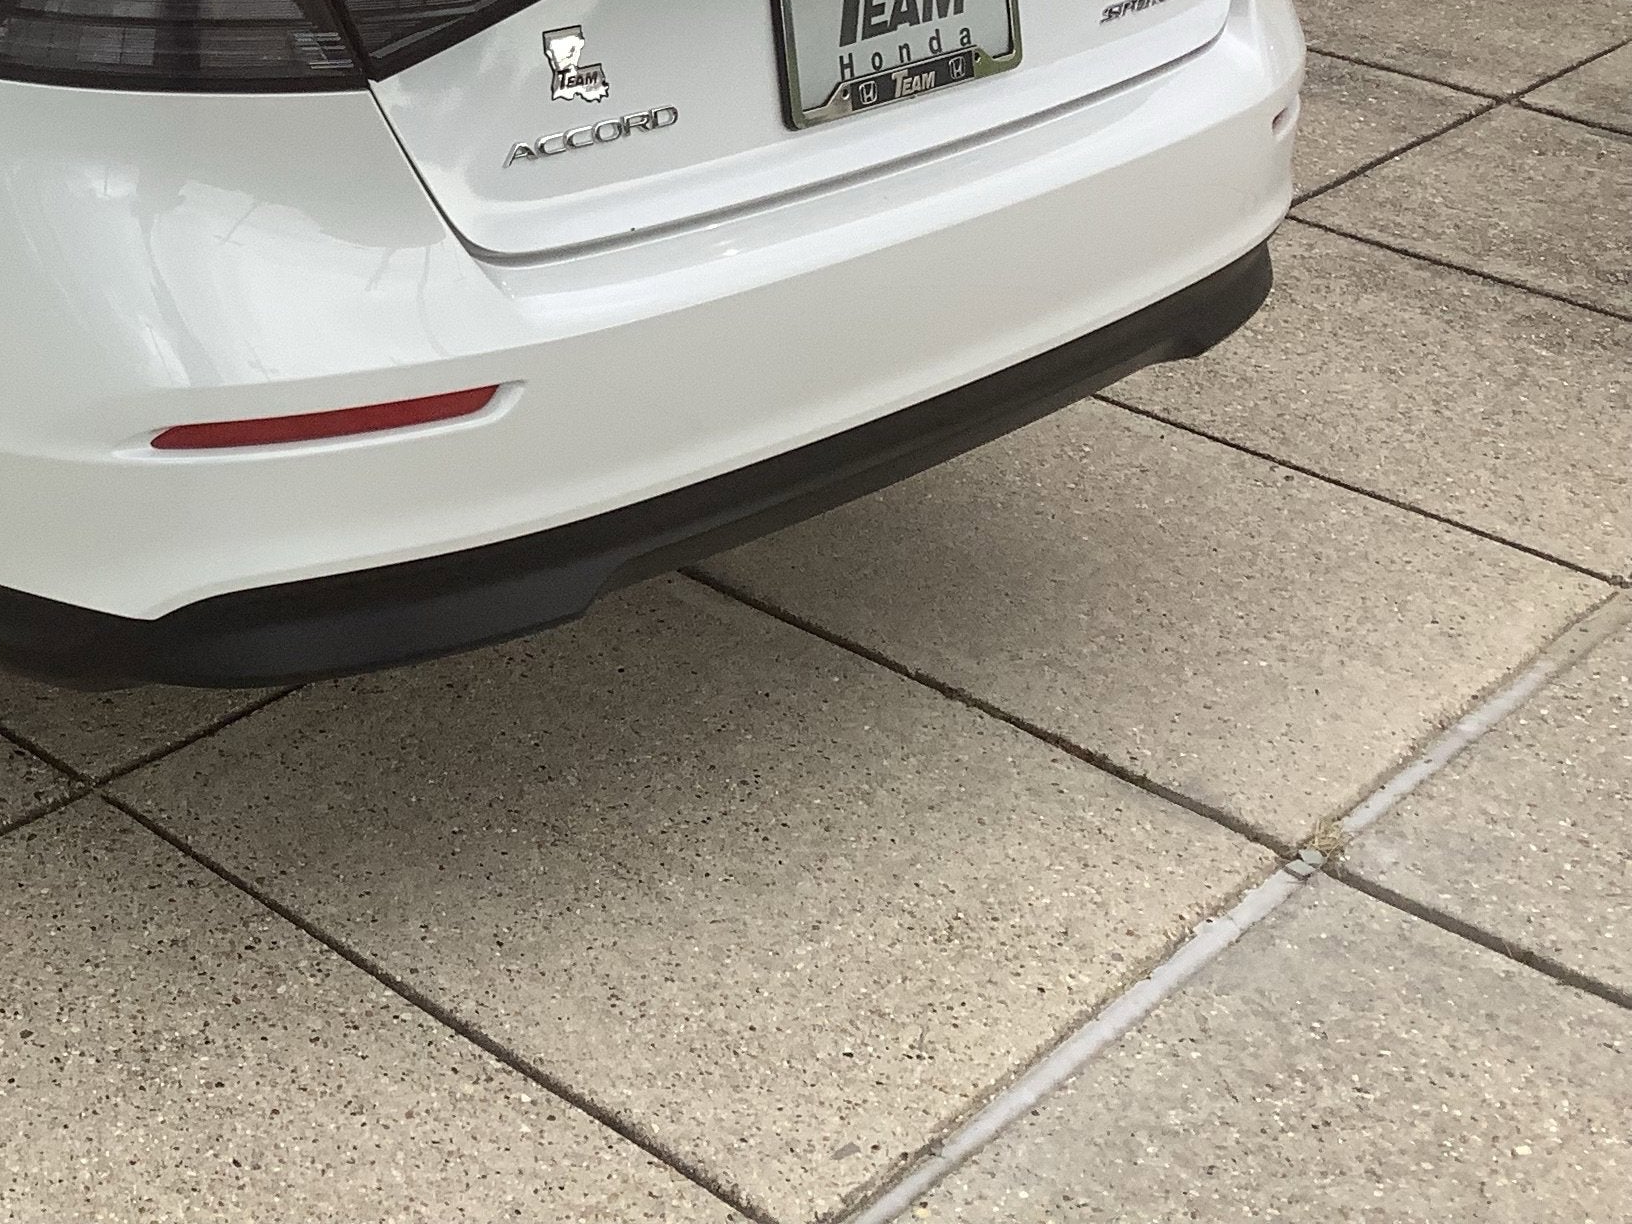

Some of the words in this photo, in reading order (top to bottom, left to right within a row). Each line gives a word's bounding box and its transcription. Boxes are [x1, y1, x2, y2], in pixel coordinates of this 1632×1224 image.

[838, 26, 972, 81] Honda
[556, 68, 599, 91] TEAM
[891, 69, 936, 99] TEAM
[502, 104, 679, 169] ACCORD
